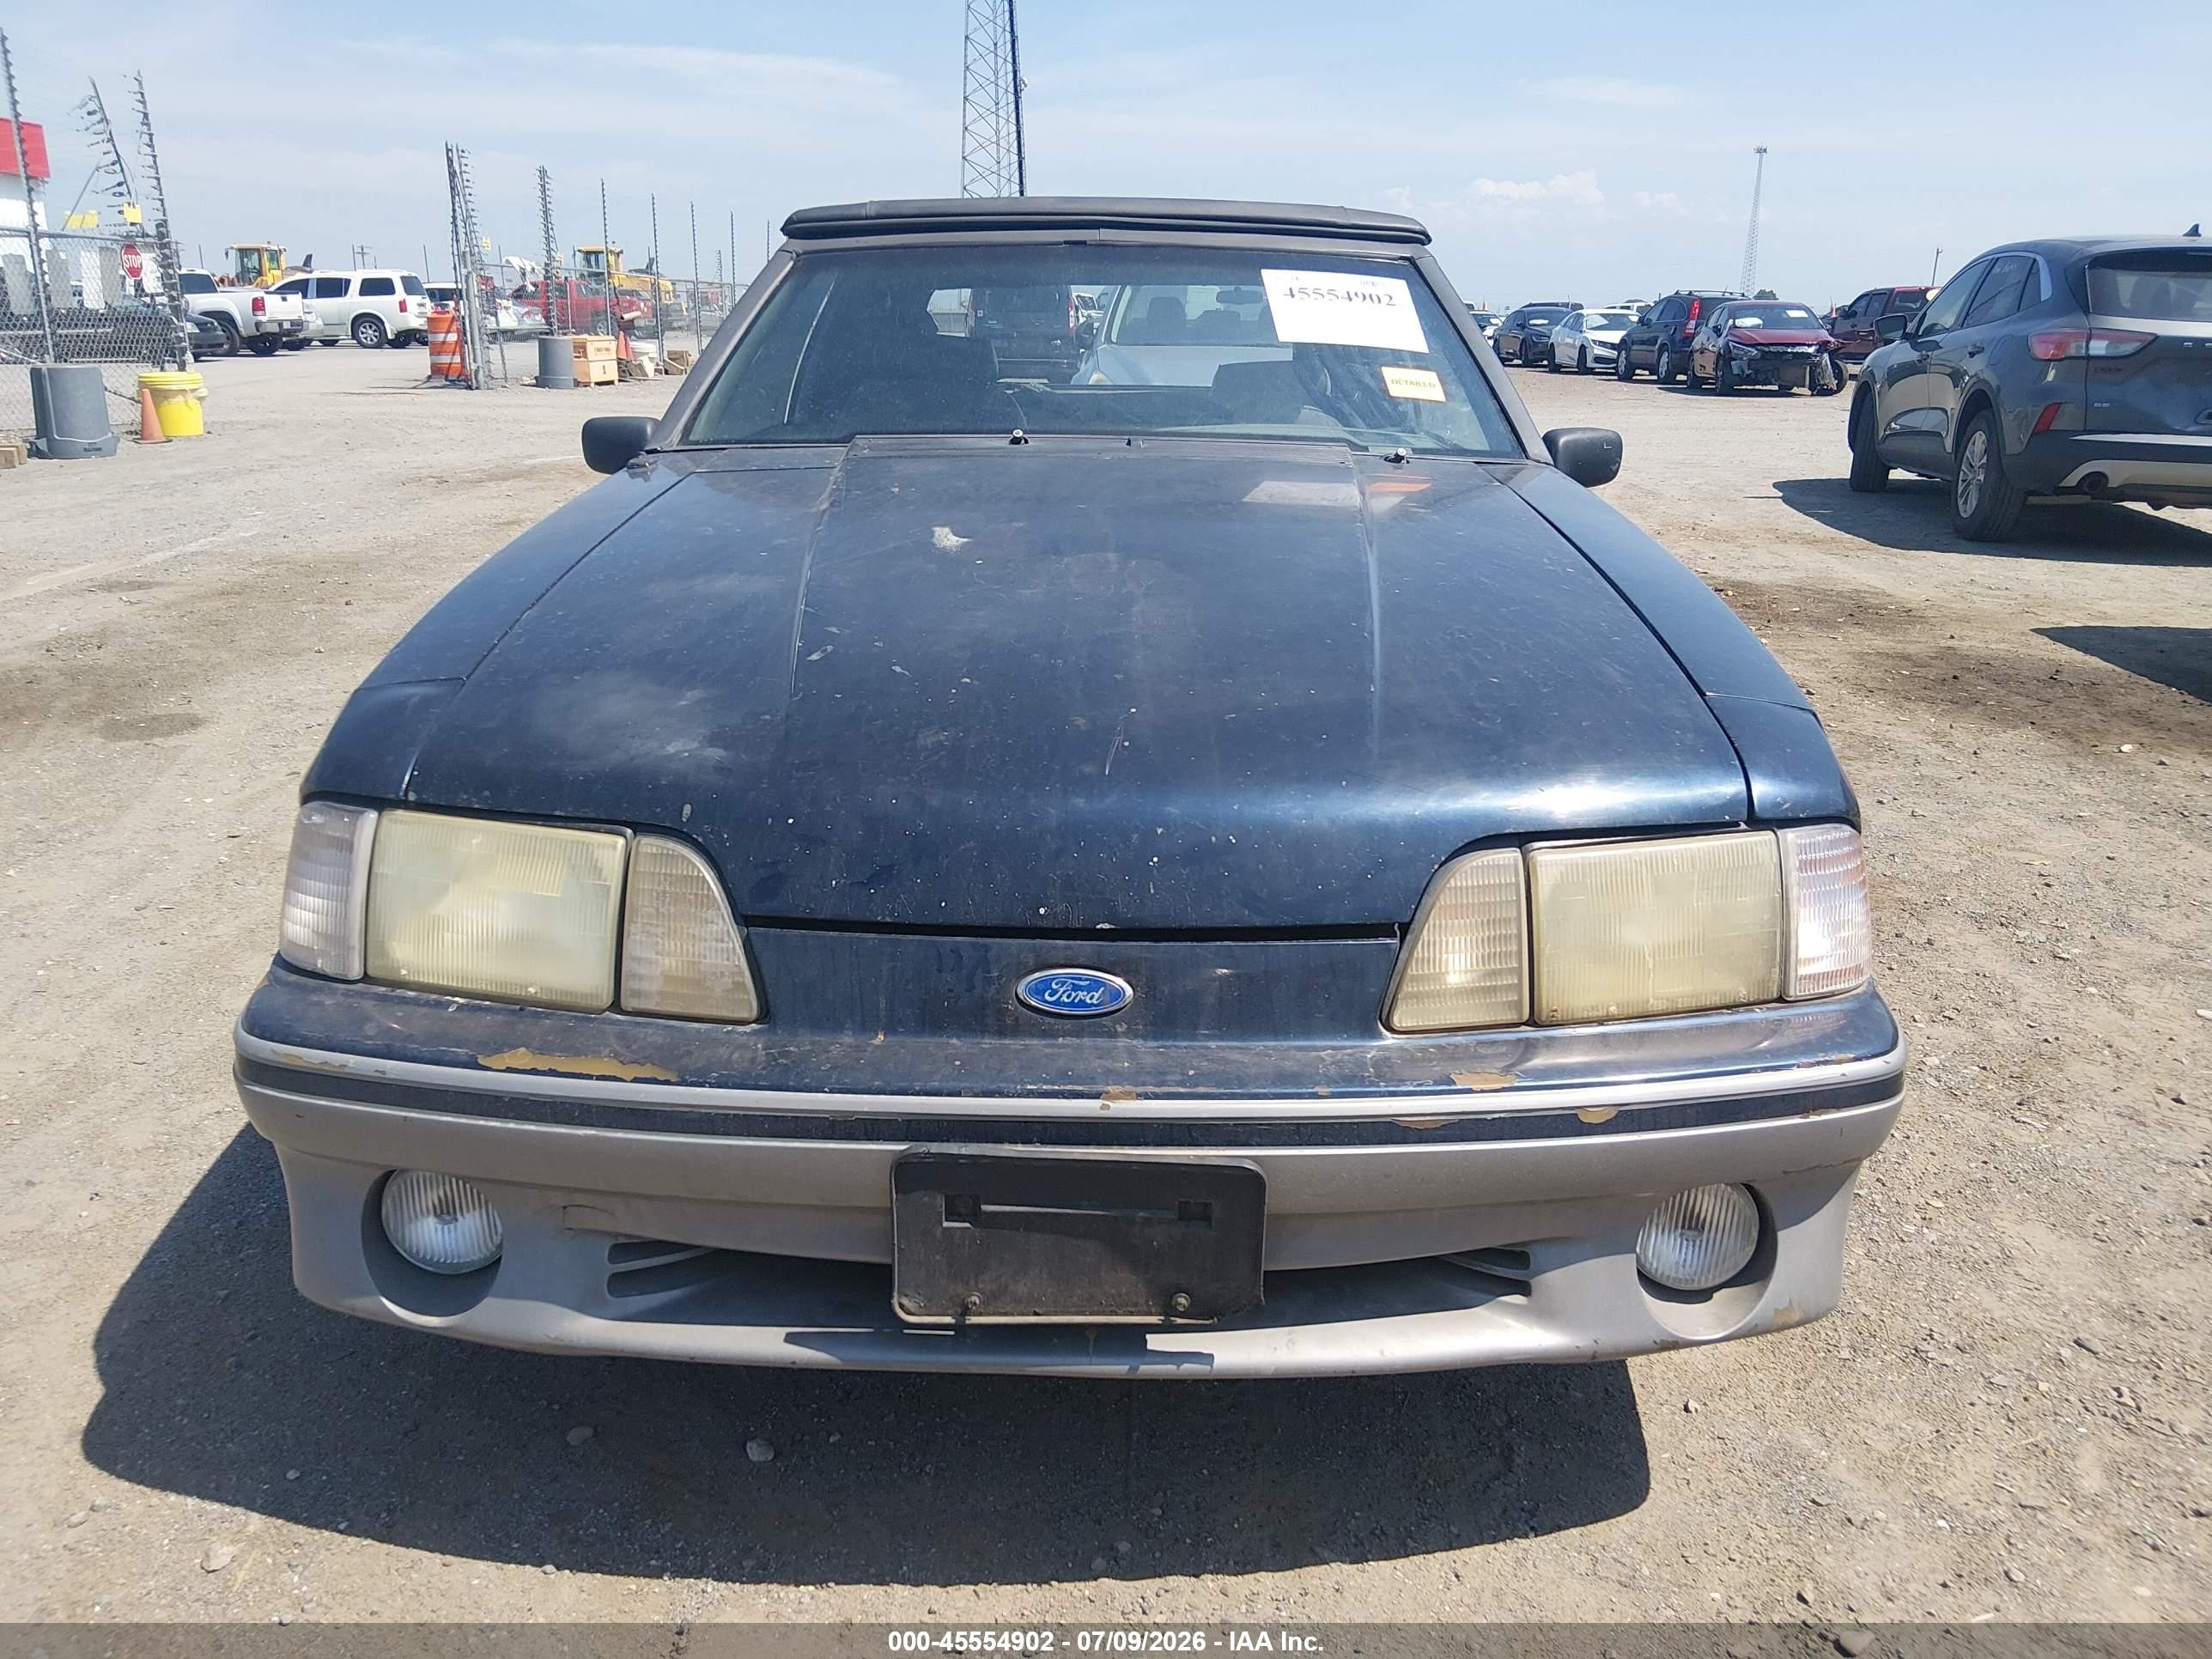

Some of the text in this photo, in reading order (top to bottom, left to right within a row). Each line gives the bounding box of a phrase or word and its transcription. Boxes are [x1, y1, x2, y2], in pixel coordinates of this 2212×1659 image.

[124, 254, 142, 268] STOP
[1283, 286, 1397, 307] 45554902
[1044, 978, 1105, 1004] Ford
